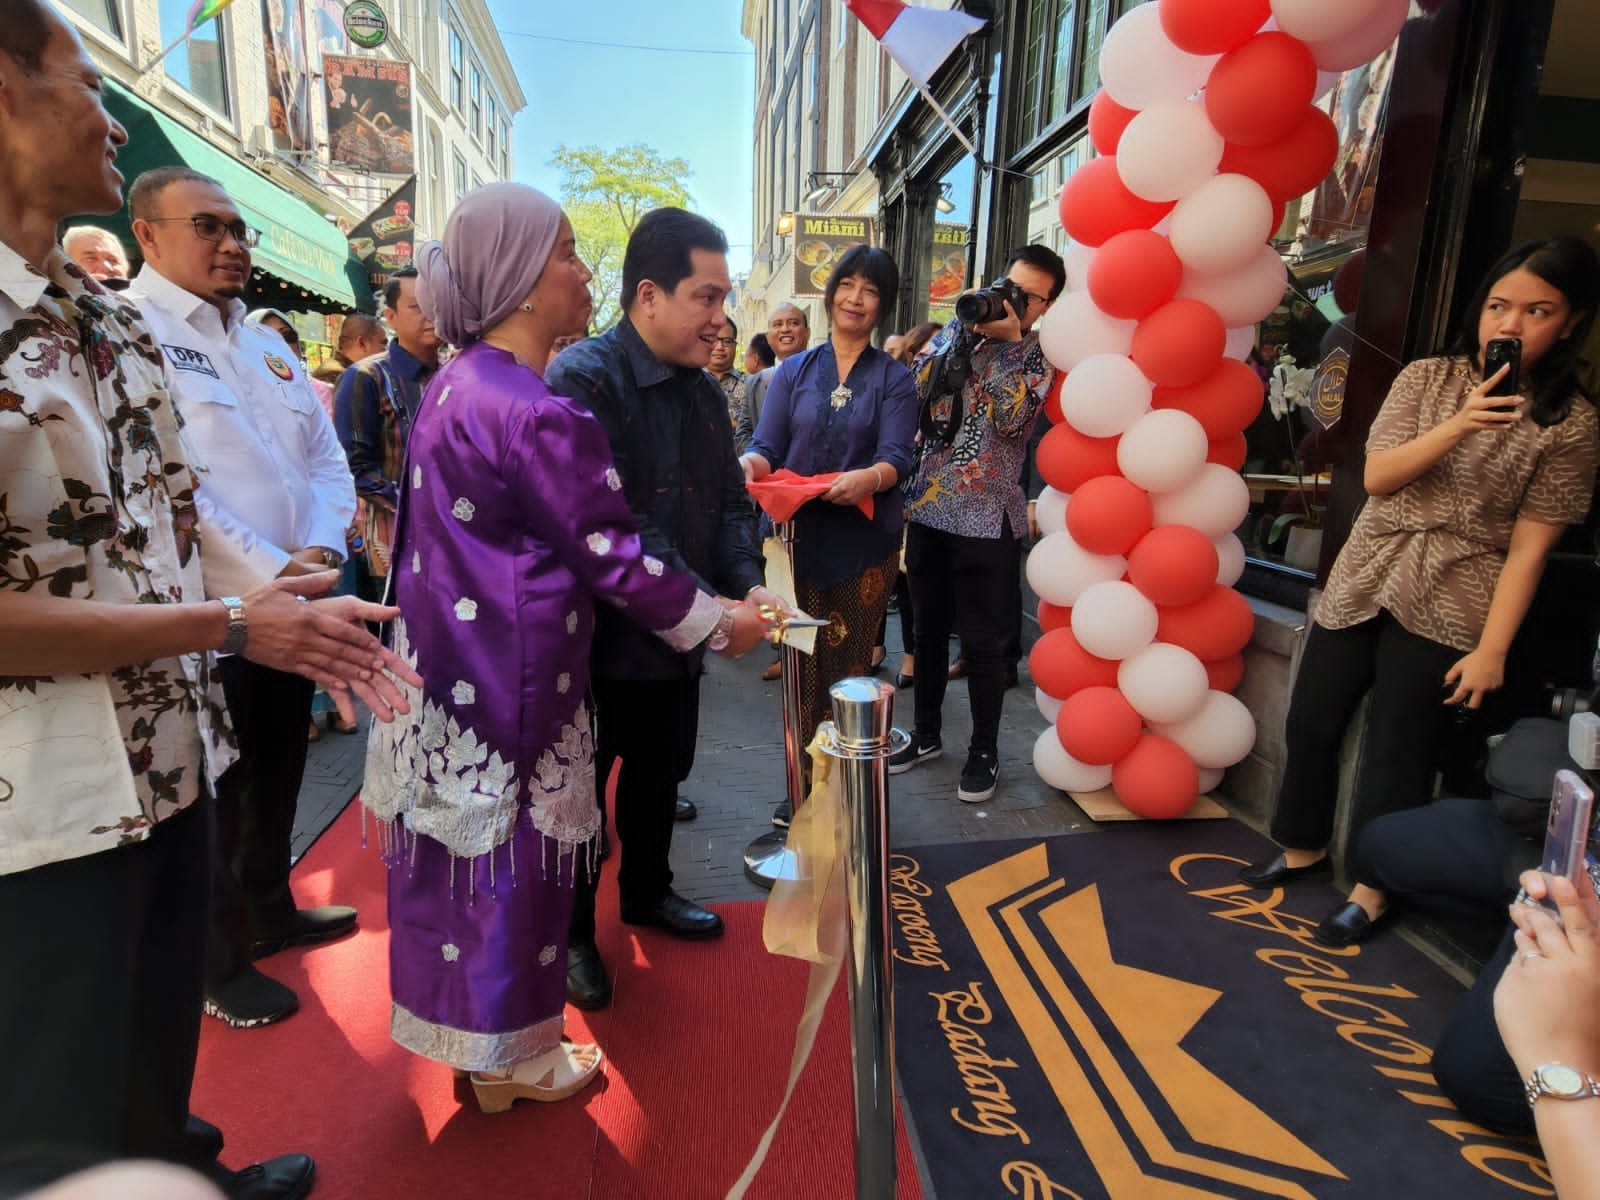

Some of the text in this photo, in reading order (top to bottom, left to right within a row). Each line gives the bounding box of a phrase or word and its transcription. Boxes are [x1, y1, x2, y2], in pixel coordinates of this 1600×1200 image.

[804, 219, 865, 237] Miami
[173, 348, 203, 365] DPP
[927, 981, 1031, 1145] Padang
